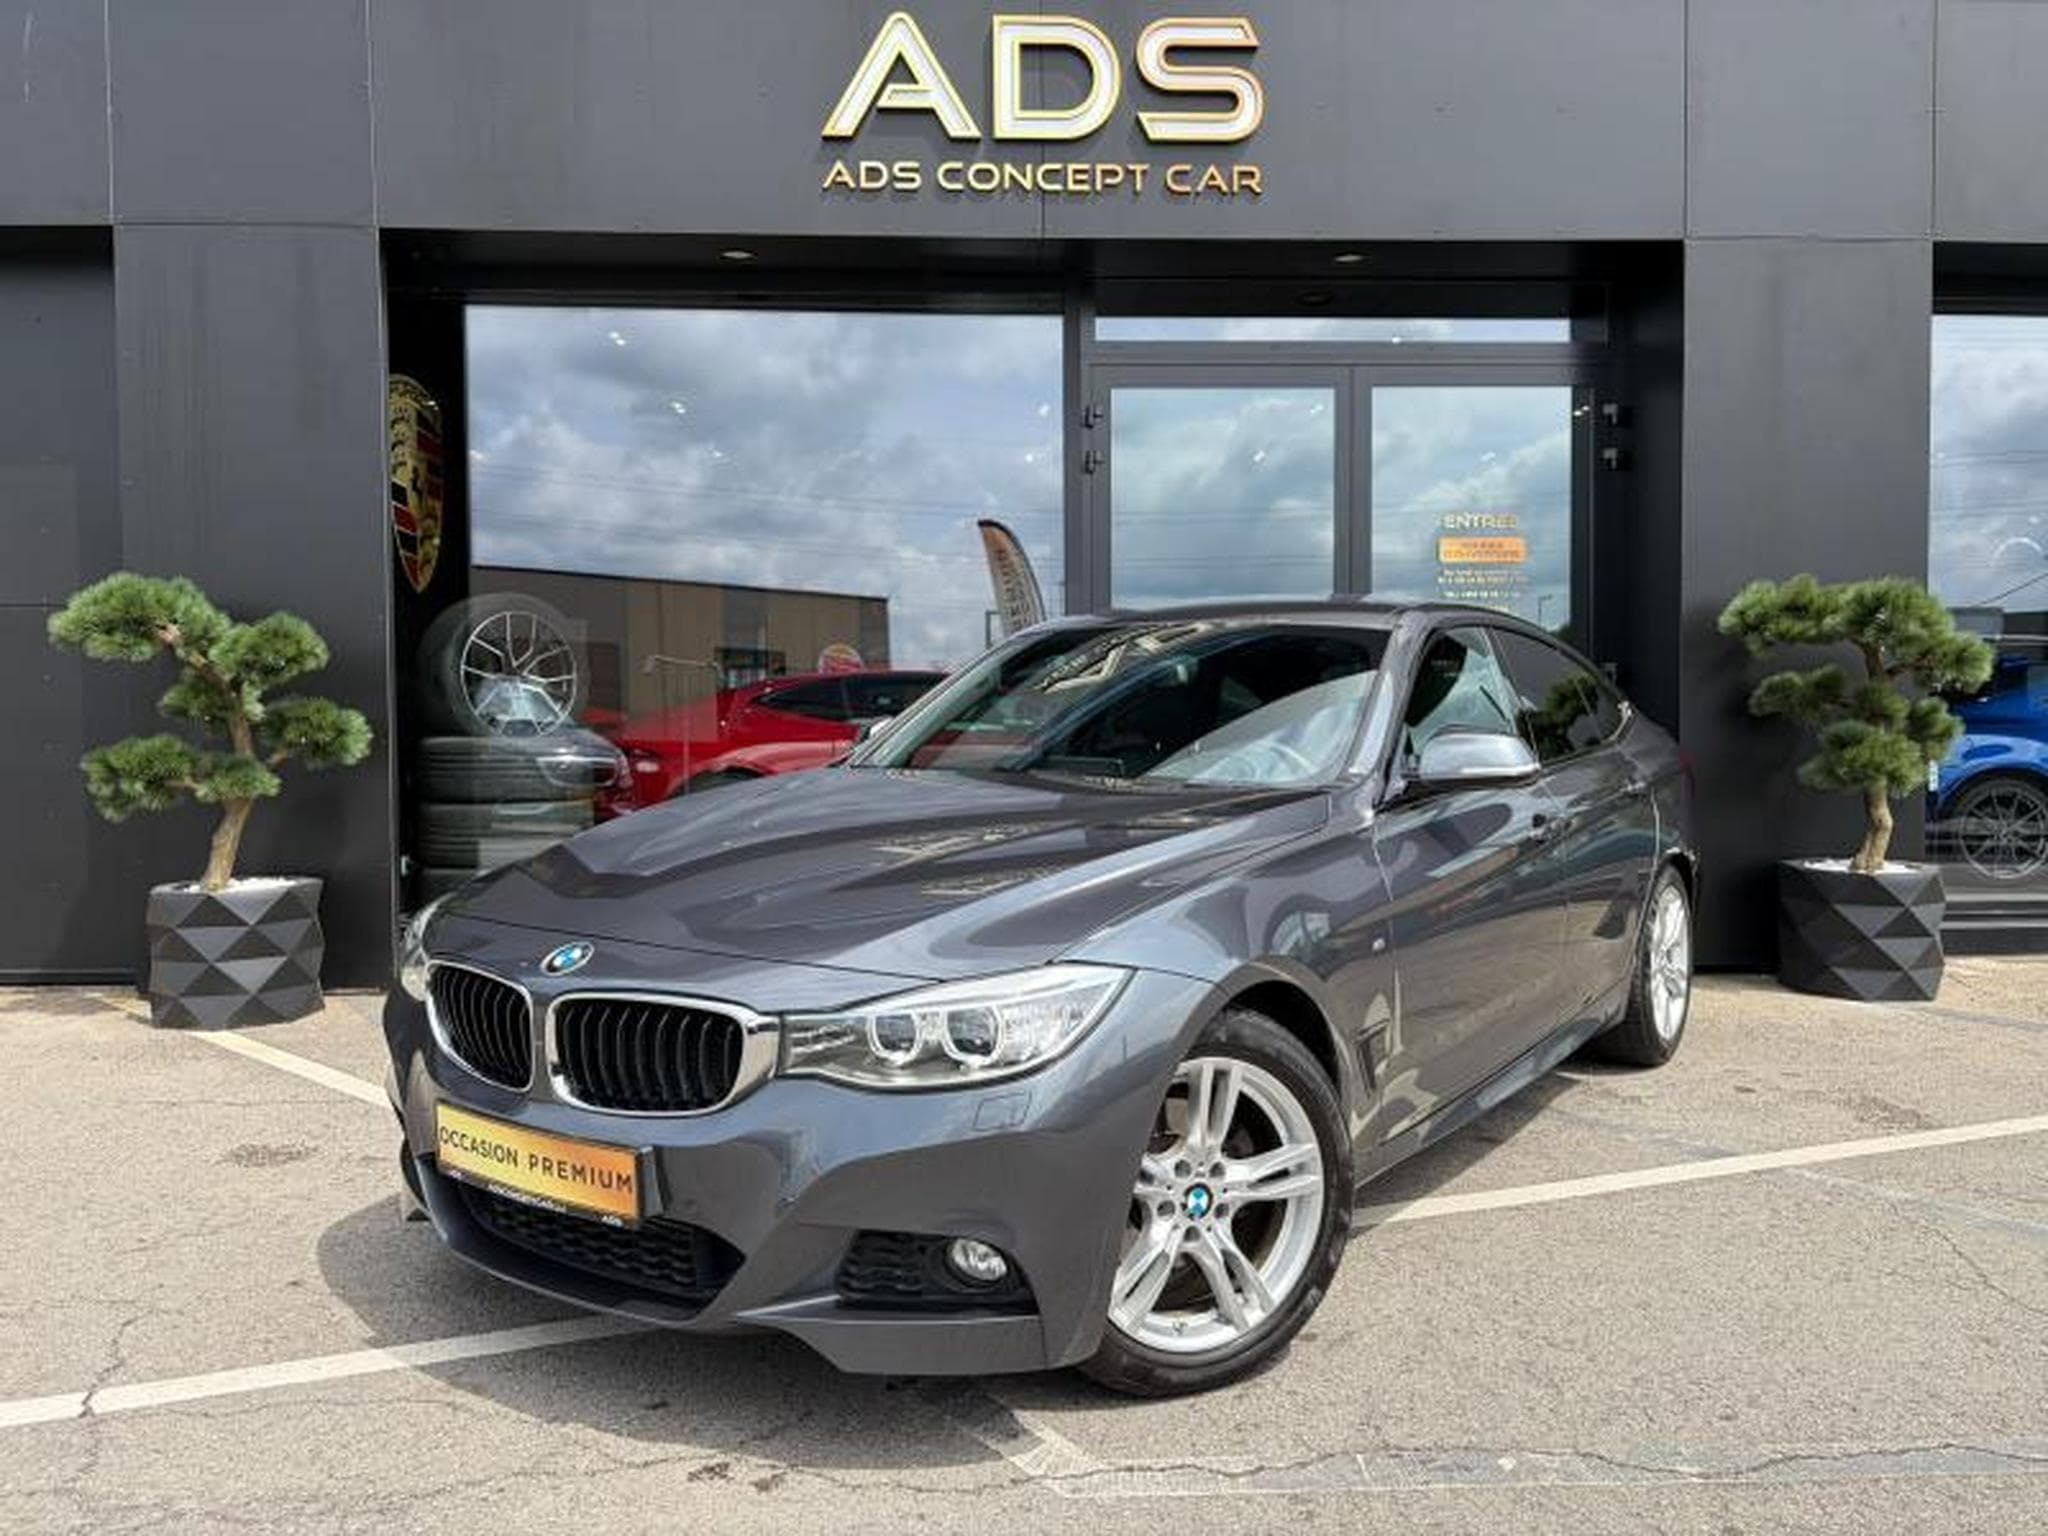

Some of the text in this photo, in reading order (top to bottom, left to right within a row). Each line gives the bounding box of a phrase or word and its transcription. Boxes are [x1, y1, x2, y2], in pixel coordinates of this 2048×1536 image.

[822, 11, 1264, 142] ADS
[822, 160, 1262, 195] ADS CONCEPT CAR
[440, 1126, 633, 1192] OCCASION PREMIUM
